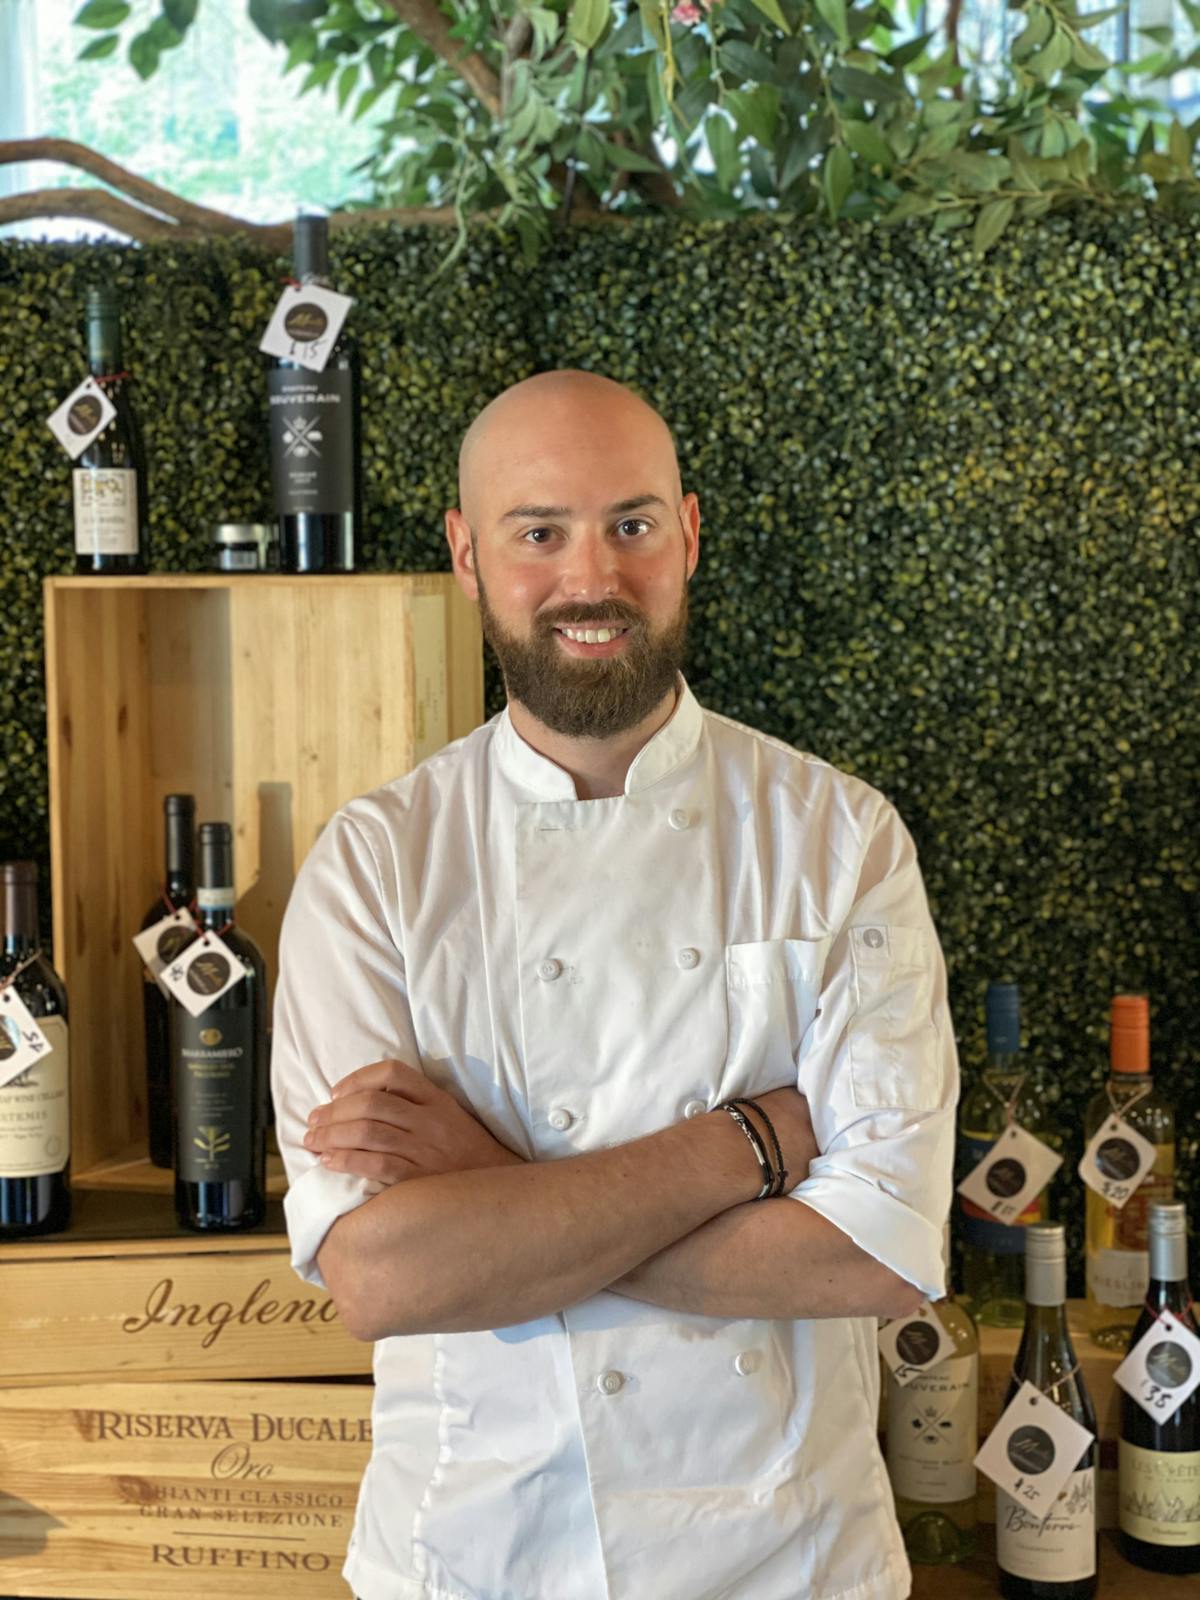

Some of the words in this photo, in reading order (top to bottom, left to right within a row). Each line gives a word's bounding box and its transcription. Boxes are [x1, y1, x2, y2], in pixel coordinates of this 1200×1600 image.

[99, 1410, 234, 1440] RISERVA
[250, 1413, 373, 1443] DUCALE
[211, 1442, 274, 1480] Oro
[143, 1484, 231, 1503] HIANTI
[240, 1489, 343, 1509] CLASSICO
[140, 1505, 202, 1520] GRAN
[213, 1508, 343, 1528] SELEZIONE
[152, 1543, 330, 1573] RUFFINO
